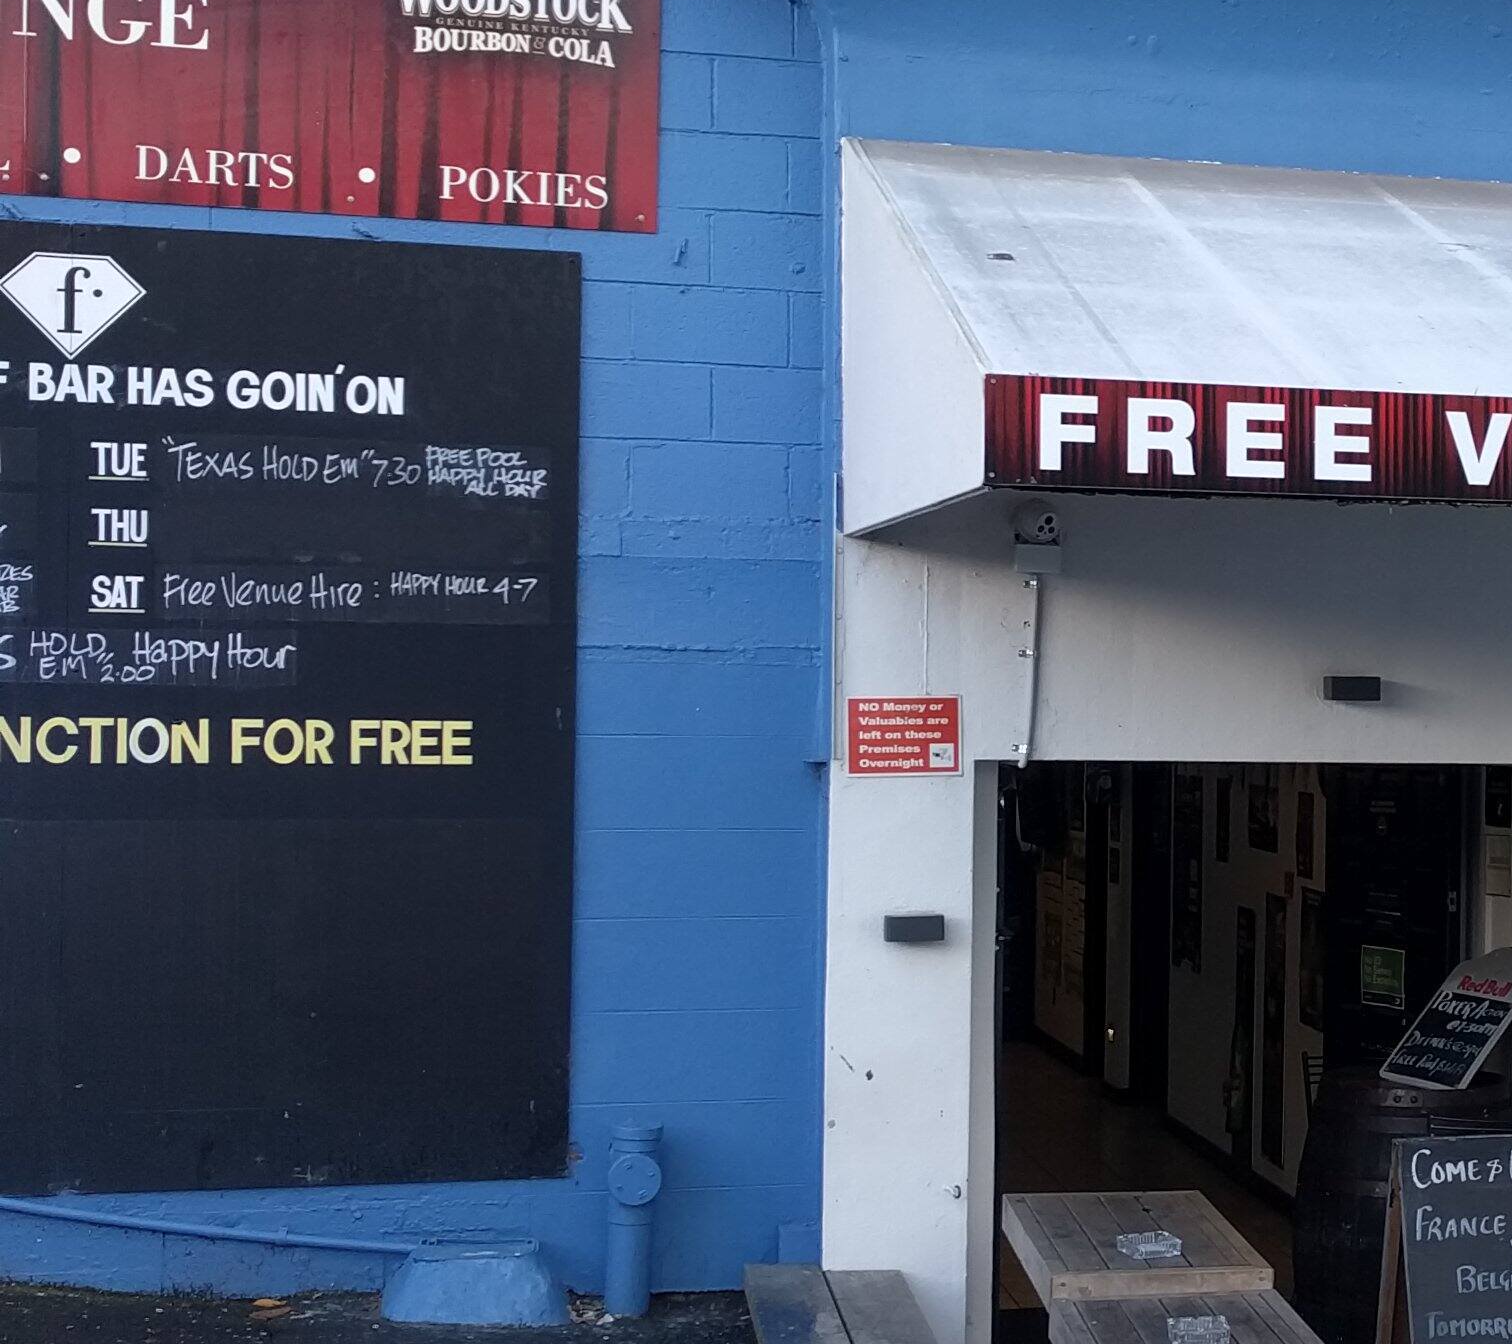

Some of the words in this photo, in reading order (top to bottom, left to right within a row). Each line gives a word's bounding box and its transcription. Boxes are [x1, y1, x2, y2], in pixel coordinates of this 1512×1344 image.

[435, 17, 504, 30] GENUINE
[511, 22, 592, 36] KENTUCKY
[413, 26, 531, 53] BOURBON
[549, 37, 616, 68] COLA
[135, 144, 295, 189] DARTS
[439, 165, 609, 210] POKIES
[28, 362, 115, 403] BAR
[127, 366, 215, 407] HAS
[1039, 393, 1373, 482] FREE
[90, 441, 148, 478] TUE
[262, 444, 318, 482] HOLD
[476, 447, 527, 467] POOL
[428, 465, 486, 487] HAPPY
[493, 467, 547, 486] HOUR
[464, 480, 499, 496] ALL
[505, 484, 541, 498] DAY
[91, 508, 148, 542] THU
[91, 575, 145, 608] SAT
[163, 572, 216, 609] Free
[221, 572, 303, 607] Venue
[390, 571, 442, 597] HAPPY
[445, 576, 489, 595] HOUR
[493, 577, 538, 604] 4-7
[30, 630, 107, 657] HOLD
[132, 631, 220, 679] Happy
[228, 633, 297, 669] Hour
[858, 716, 923, 725] Valuables
[927, 717, 949, 725] are
[859, 702, 879, 711] NO
[883, 702, 926, 713] Money
[929, 703, 943, 711] or
[0, 716, 209, 764] NCTION
[230, 718, 334, 765] FOR
[350, 720, 474, 765] FREE
[859, 730, 881, 739] left
[885, 731, 901, 739] on
[905, 730, 942, 739] these
[859, 744, 920, 753] Premises
[860, 758, 924, 769] Overnight
[1411, 1148, 1482, 1188] COME
[1416, 1205, 1507, 1242] FRANCE
